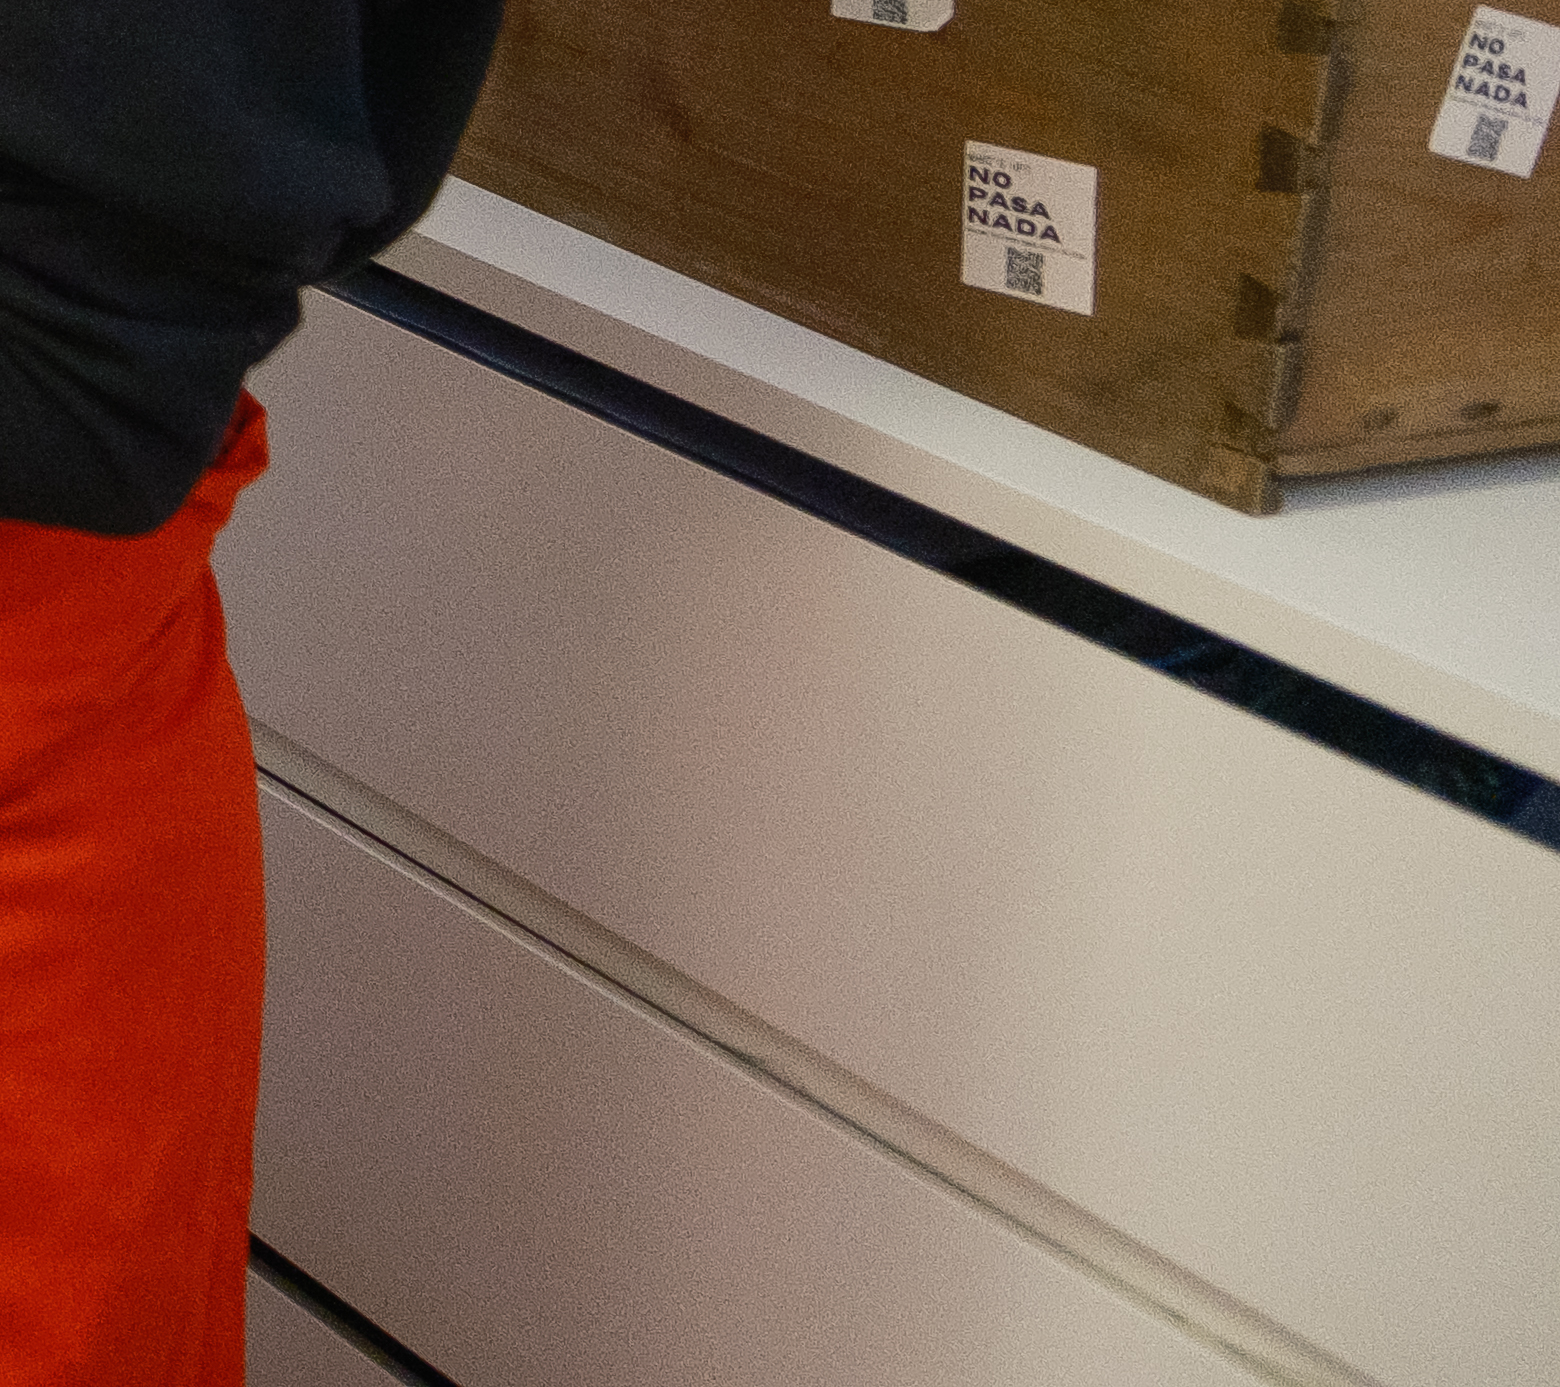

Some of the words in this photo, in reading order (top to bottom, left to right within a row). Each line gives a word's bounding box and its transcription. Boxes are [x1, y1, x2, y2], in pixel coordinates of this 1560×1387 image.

[1468, 32, 1507, 56] NO
[1462, 52, 1527, 86] PASA
[1454, 74, 1528, 109] NADA
[969, 165, 1013, 190] NO
[968, 186, 1052, 221] PASA
[967, 206, 1062, 245] NADA
